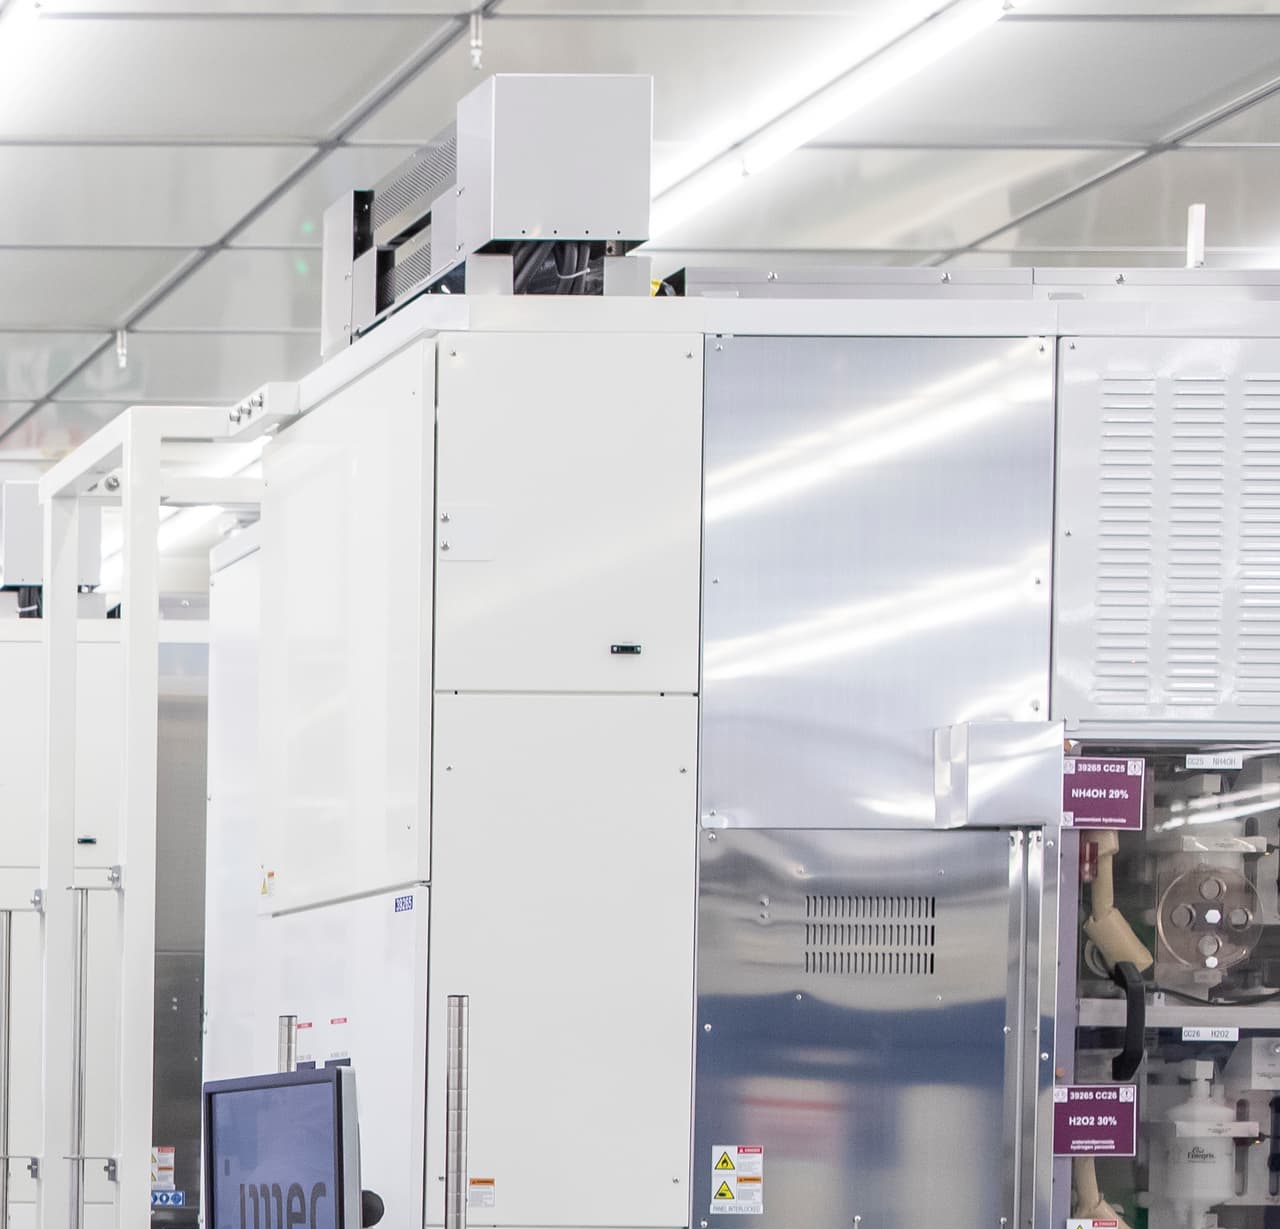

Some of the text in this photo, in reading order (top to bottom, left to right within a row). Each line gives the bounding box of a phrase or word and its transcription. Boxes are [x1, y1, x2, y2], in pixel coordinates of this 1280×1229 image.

[1071, 788, 1129, 799] NH4OH 29%
[1070, 1091, 1094, 1100] 39265
[1097, 1116, 1117, 1126] 30%
